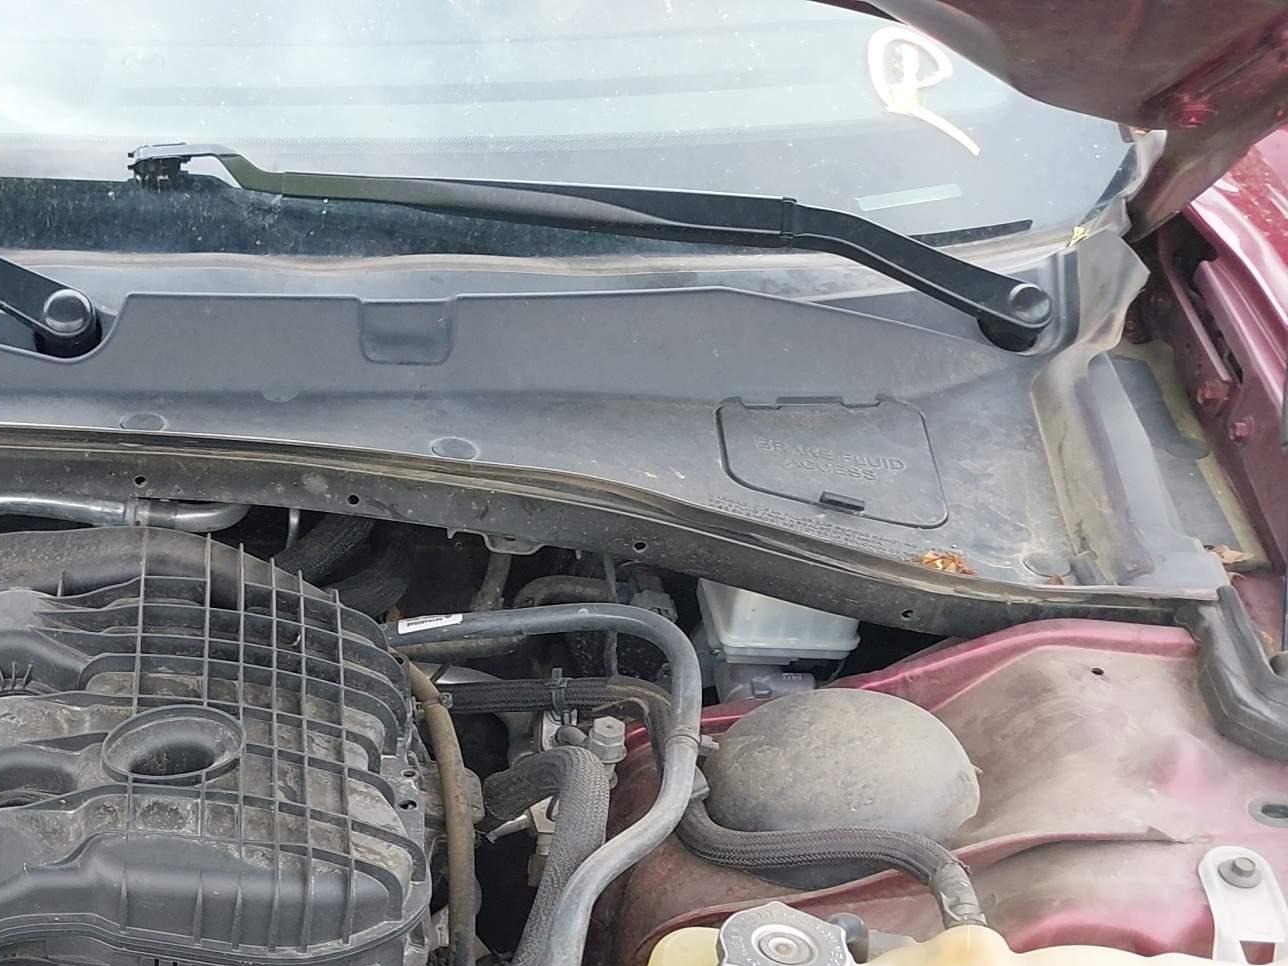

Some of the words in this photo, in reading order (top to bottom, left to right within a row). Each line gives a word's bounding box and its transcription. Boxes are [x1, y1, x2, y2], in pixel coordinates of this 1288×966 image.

[755, 438, 834, 461] BRAKE
[838, 451, 907, 471] FLUID
[782, 457, 877, 481] ACCESS
